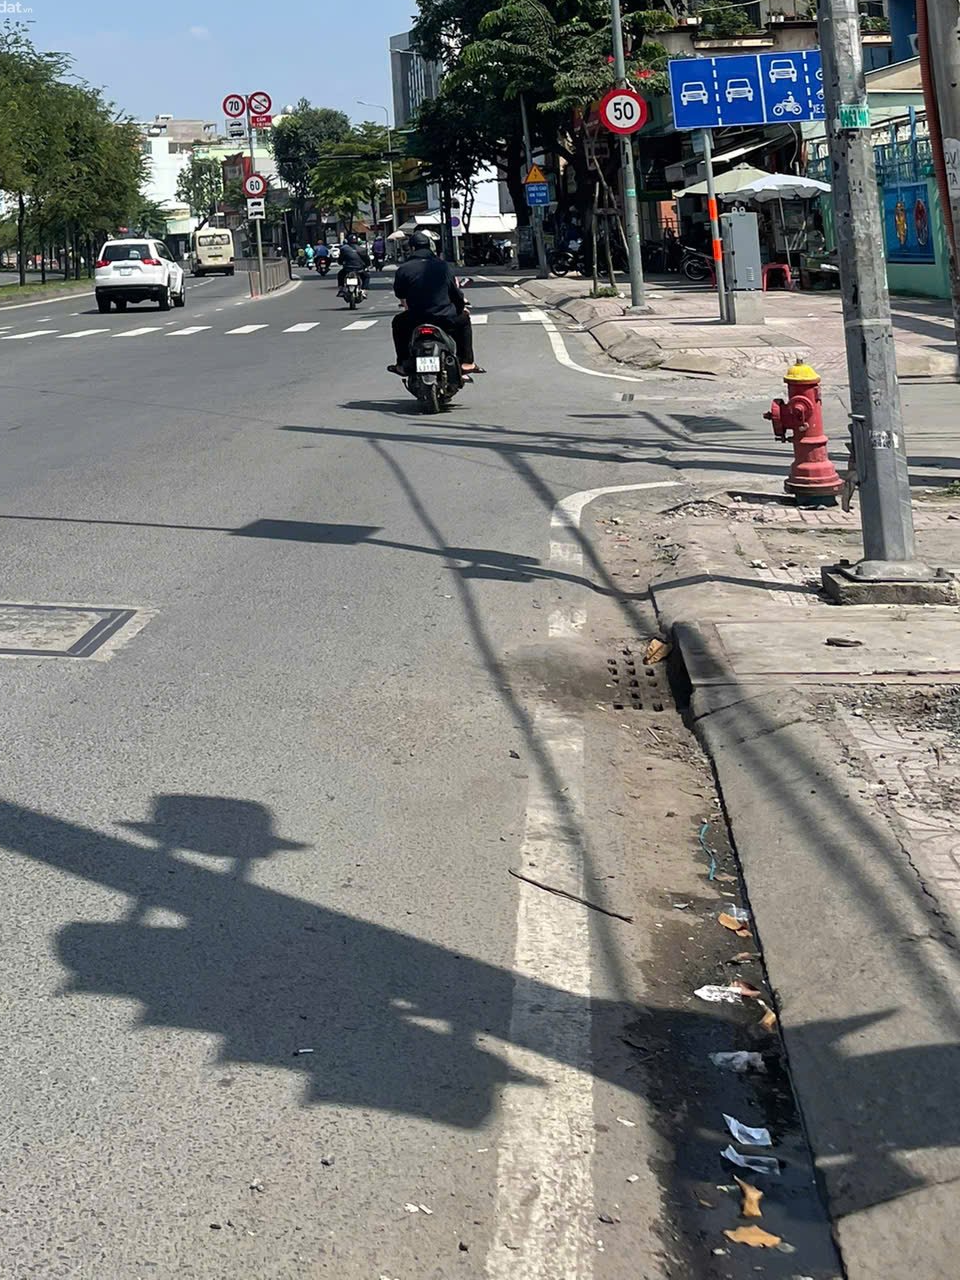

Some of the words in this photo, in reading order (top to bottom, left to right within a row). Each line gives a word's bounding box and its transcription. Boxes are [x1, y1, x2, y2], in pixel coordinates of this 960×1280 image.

[228, 100, 240, 111] 70
[613, 101, 634, 120] 50
[249, 180, 260, 191] 60
